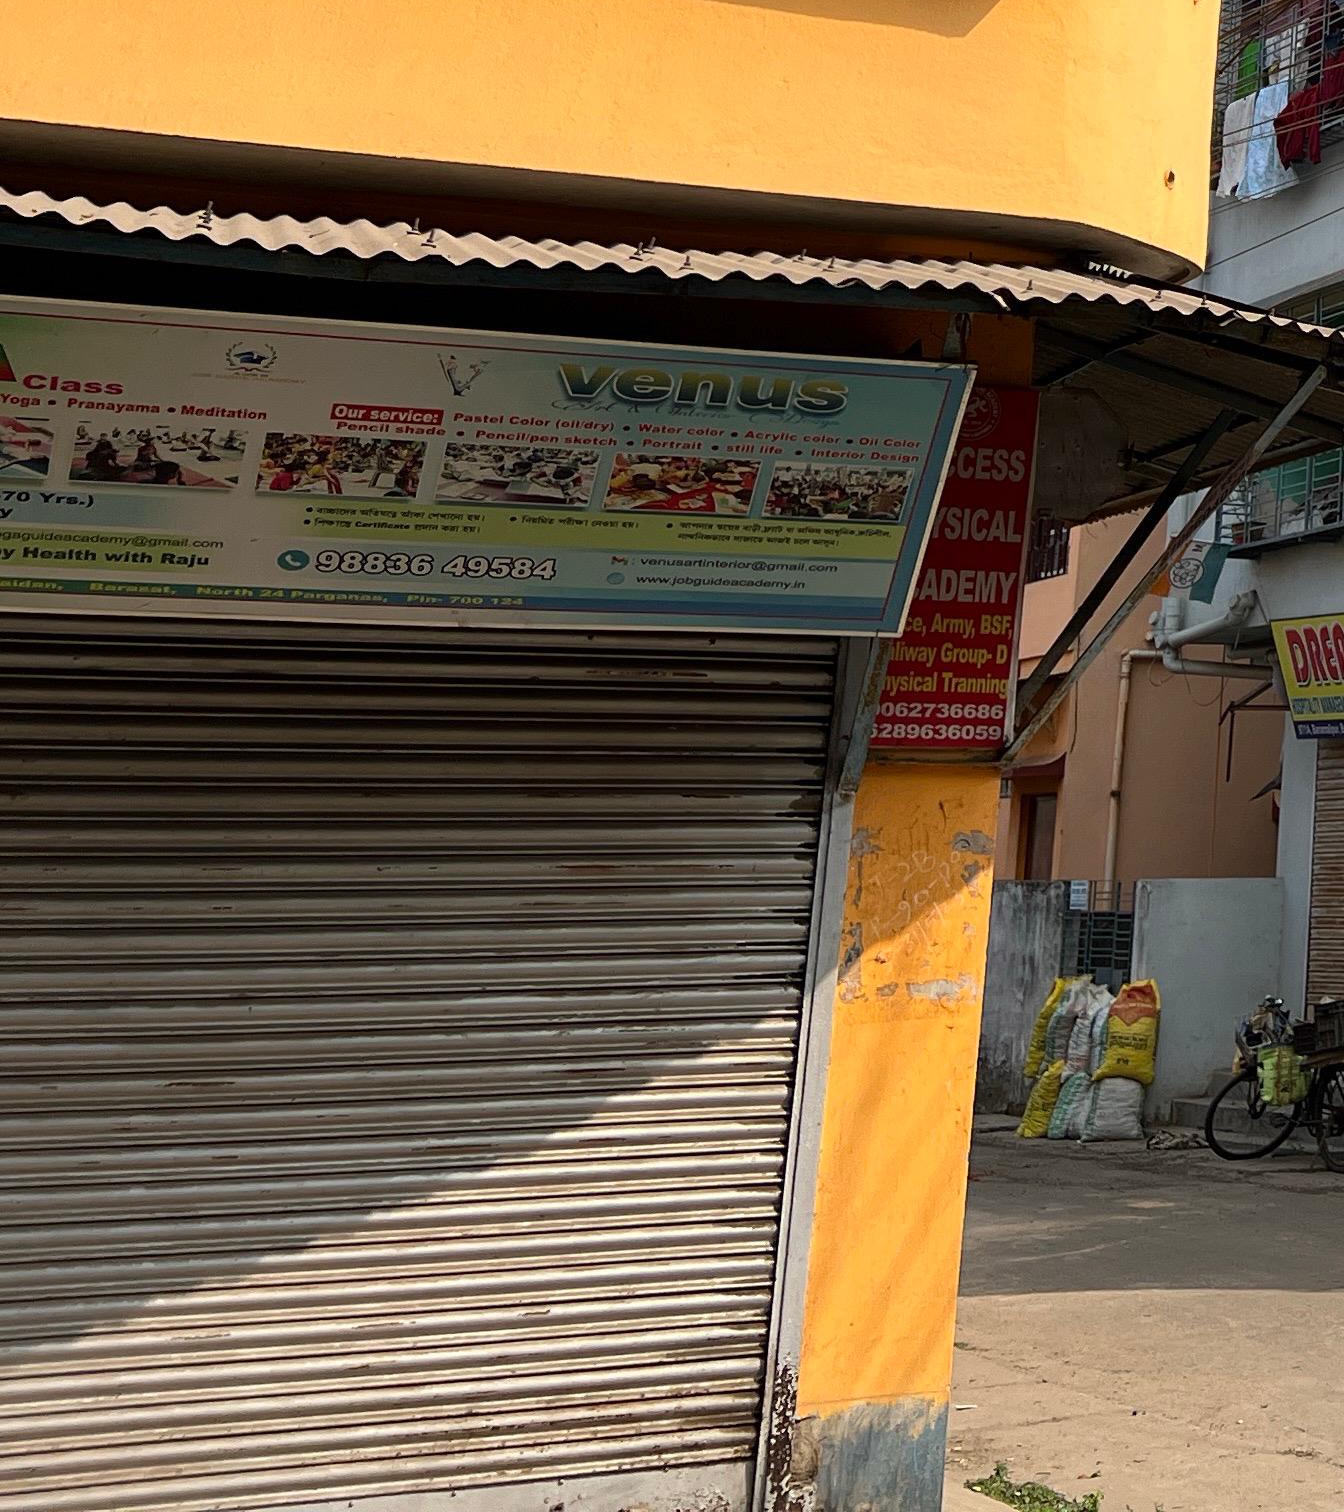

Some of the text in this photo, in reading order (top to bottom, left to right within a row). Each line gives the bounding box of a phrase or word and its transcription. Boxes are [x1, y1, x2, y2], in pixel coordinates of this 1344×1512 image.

[23, 374, 124, 395] Class
[558, 362, 849, 414] venus
[0, 393, 267, 420] Yoga Pranayama Meditation
[334, 405, 439, 424] Our service:
[337, 421, 919, 462] Pencil shade Pencil/pen sketch Portrait still life Interior Design
[454, 413, 922, 449] Pastel Color (oil/dry) Water color Acrylic color Oil Color
[40, 492, 94, 508] Yrs.)
[22, 547, 97, 561] Health
[105, 551, 153, 564] with
[161, 553, 209, 567] Raju
[316, 549, 557, 581] 98836 49584
[640, 556, 837, 573] venusartinterior@gmail.com
[636, 574, 805, 590] www.jobguideacademy.in
[930, 612, 976, 639] Army,
[980, 614, 1012, 640] BSF,
[996, 643, 1008, 665] D
[875, 702, 1004, 719] 062736686
